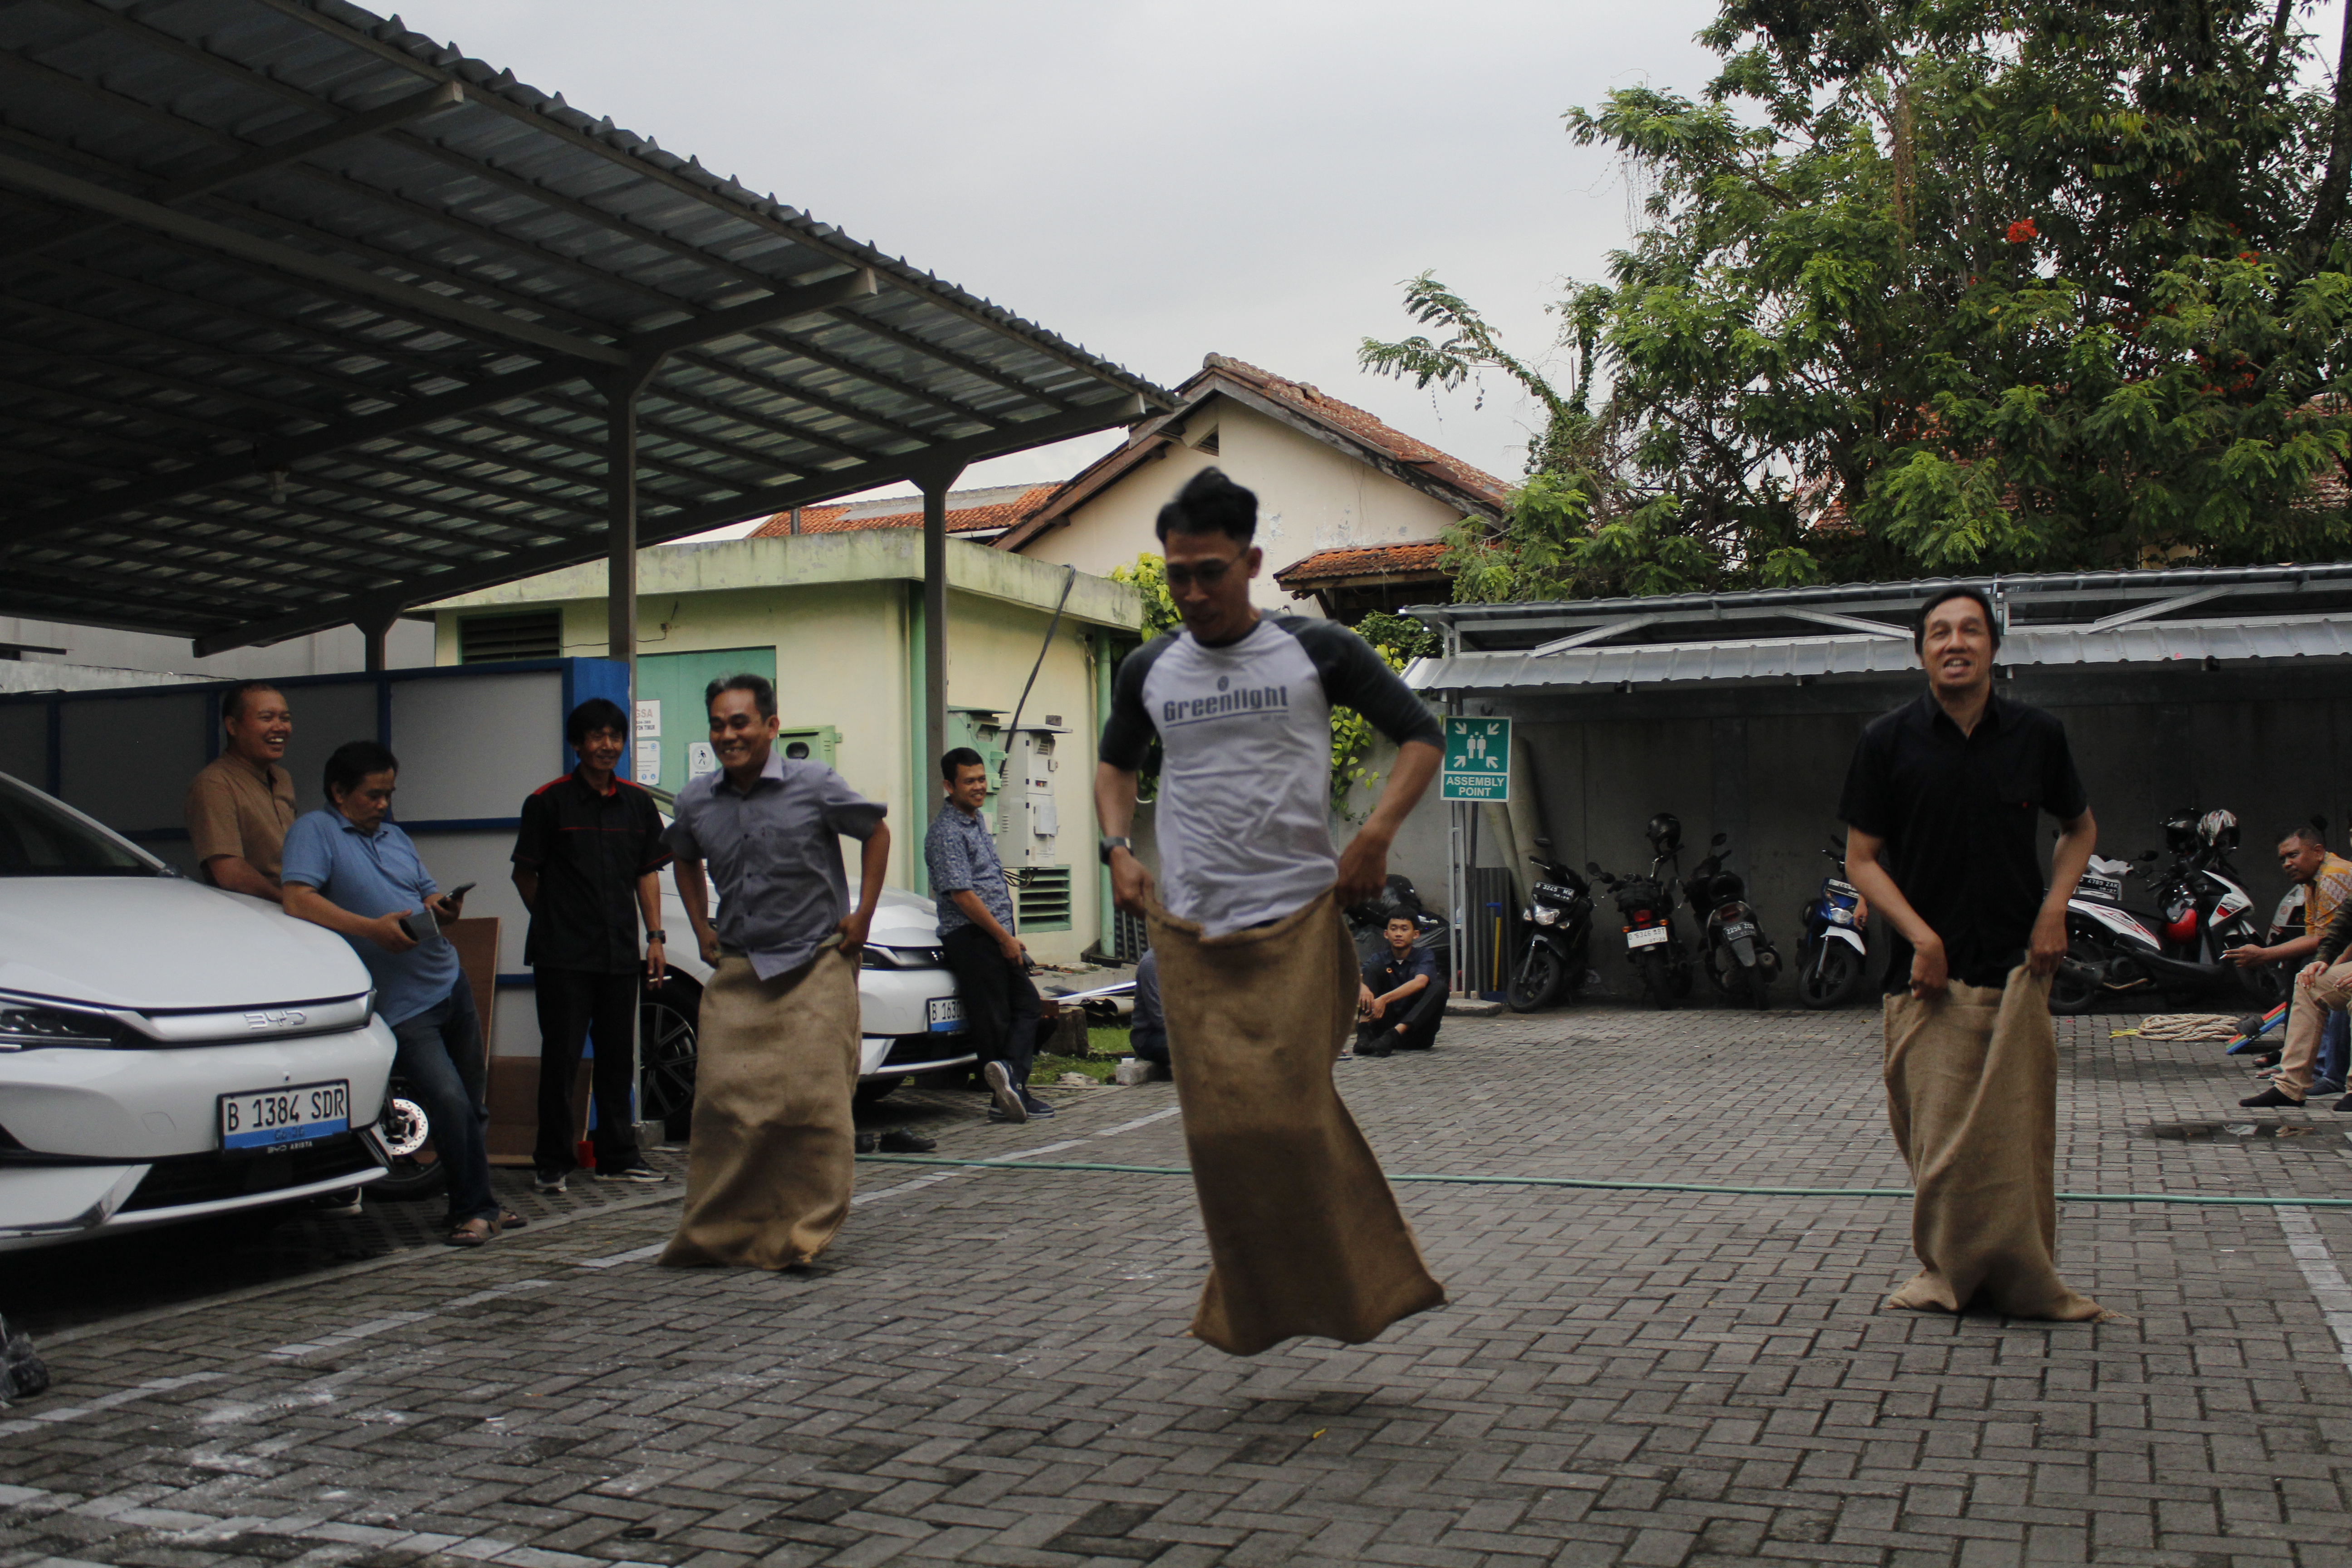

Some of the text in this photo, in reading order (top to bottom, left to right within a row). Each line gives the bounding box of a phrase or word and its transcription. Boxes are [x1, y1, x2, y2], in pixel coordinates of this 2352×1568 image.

[1163, 686, 1289, 722] Greenlight
[1446, 776, 1504, 786] ASSEMBLY
[1459, 787, 1491, 796] POINT
[244, 1010, 307, 1029] BYD
[932, 1003, 936, 1020] B
[228, 1088, 345, 1131] B 1384 SDR
[290, 1141, 313, 1150] ARISTA
